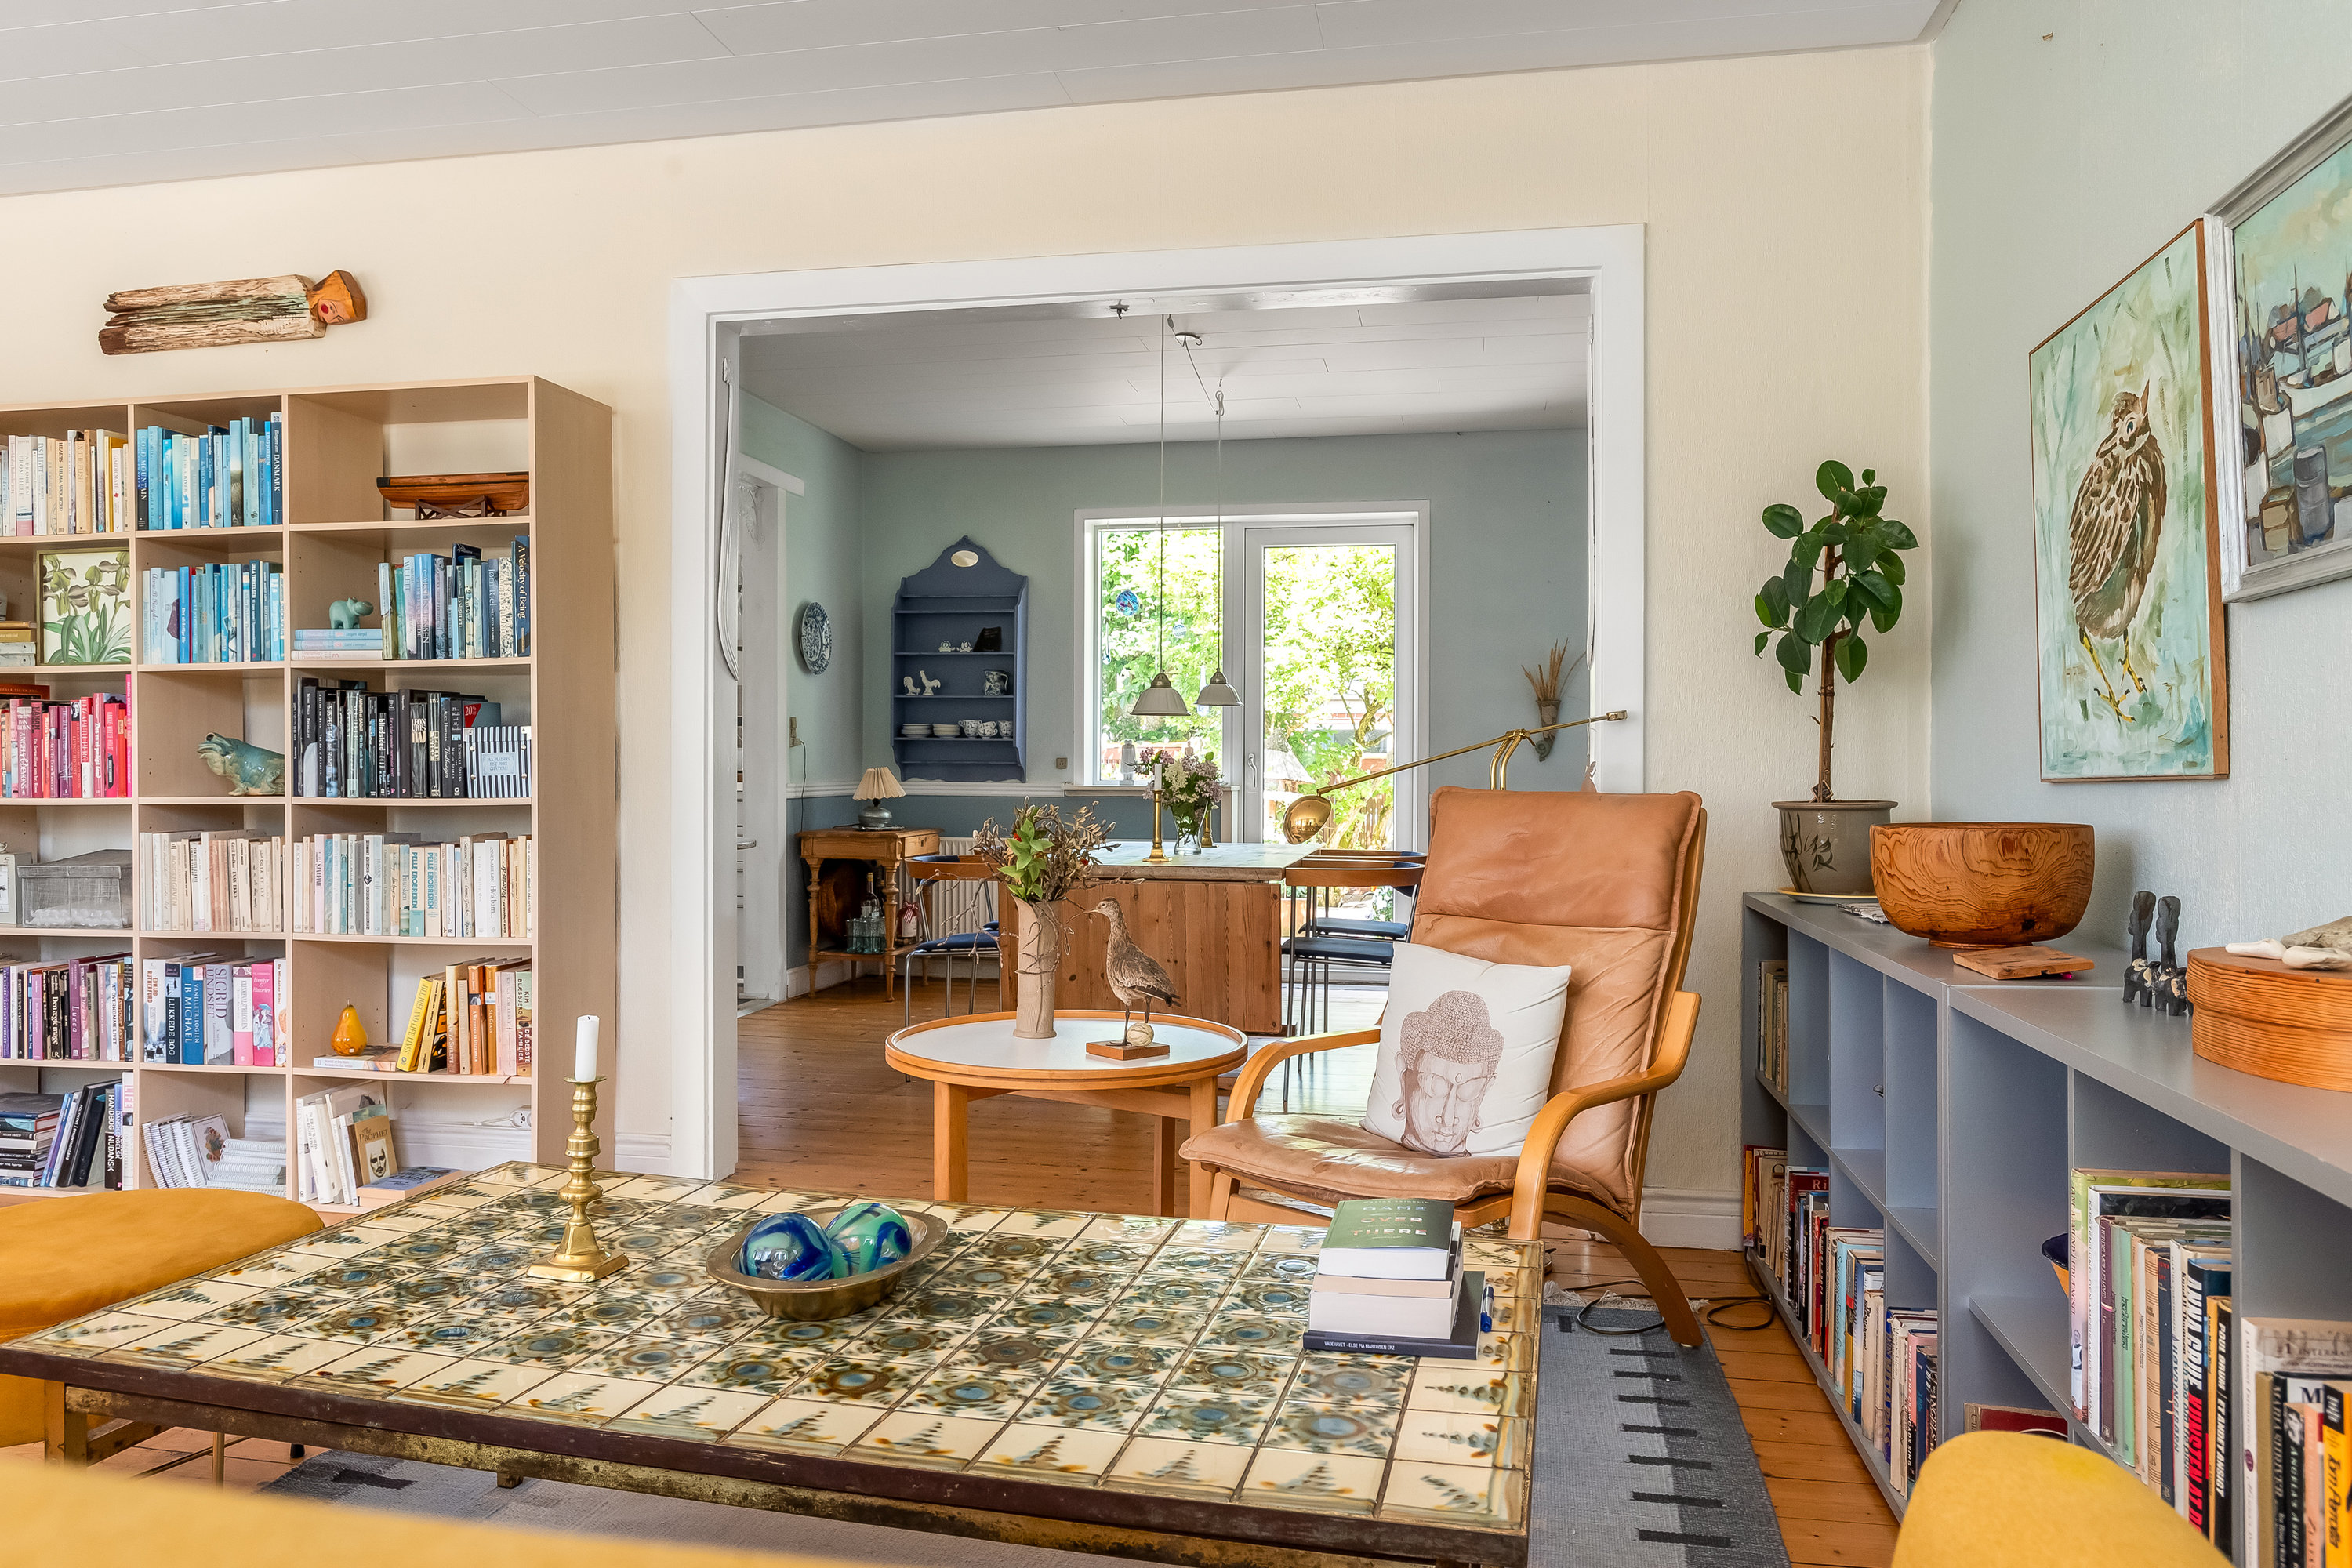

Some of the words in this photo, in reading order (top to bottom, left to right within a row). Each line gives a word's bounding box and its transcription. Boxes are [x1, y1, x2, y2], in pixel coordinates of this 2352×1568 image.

[518, 554, 527, 584] Velocity
[517, 597, 527, 619] Being
[185, 983, 192, 993] IB
[206, 969, 215, 1018] UNDSET
[215, 968, 227, 1019] SIGRID
[412, 998, 426, 1023] IRELAND
[408, 1023, 419, 1036] LIFE
[524, 1029, 531, 1038] DE
[404, 1036, 415, 1054] LINES
[74, 1104, 83, 1125] POLITIKENS
[358, 1129, 389, 1143] PROPHET
[2187, 1275, 2203, 1330] ANNA
[2217, 1322, 2226, 1352] POUL
[2187, 1333, 2203, 1391] GRUE
[2273, 1385, 2282, 1430] MARIA
[2188, 1391, 2203, 1483] KUNSTEN
[2273, 1432, 2283, 1497] SHRIVER
[2189, 1483, 2203, 1509] AT
[2291, 1512, 2299, 1555] ASHES
